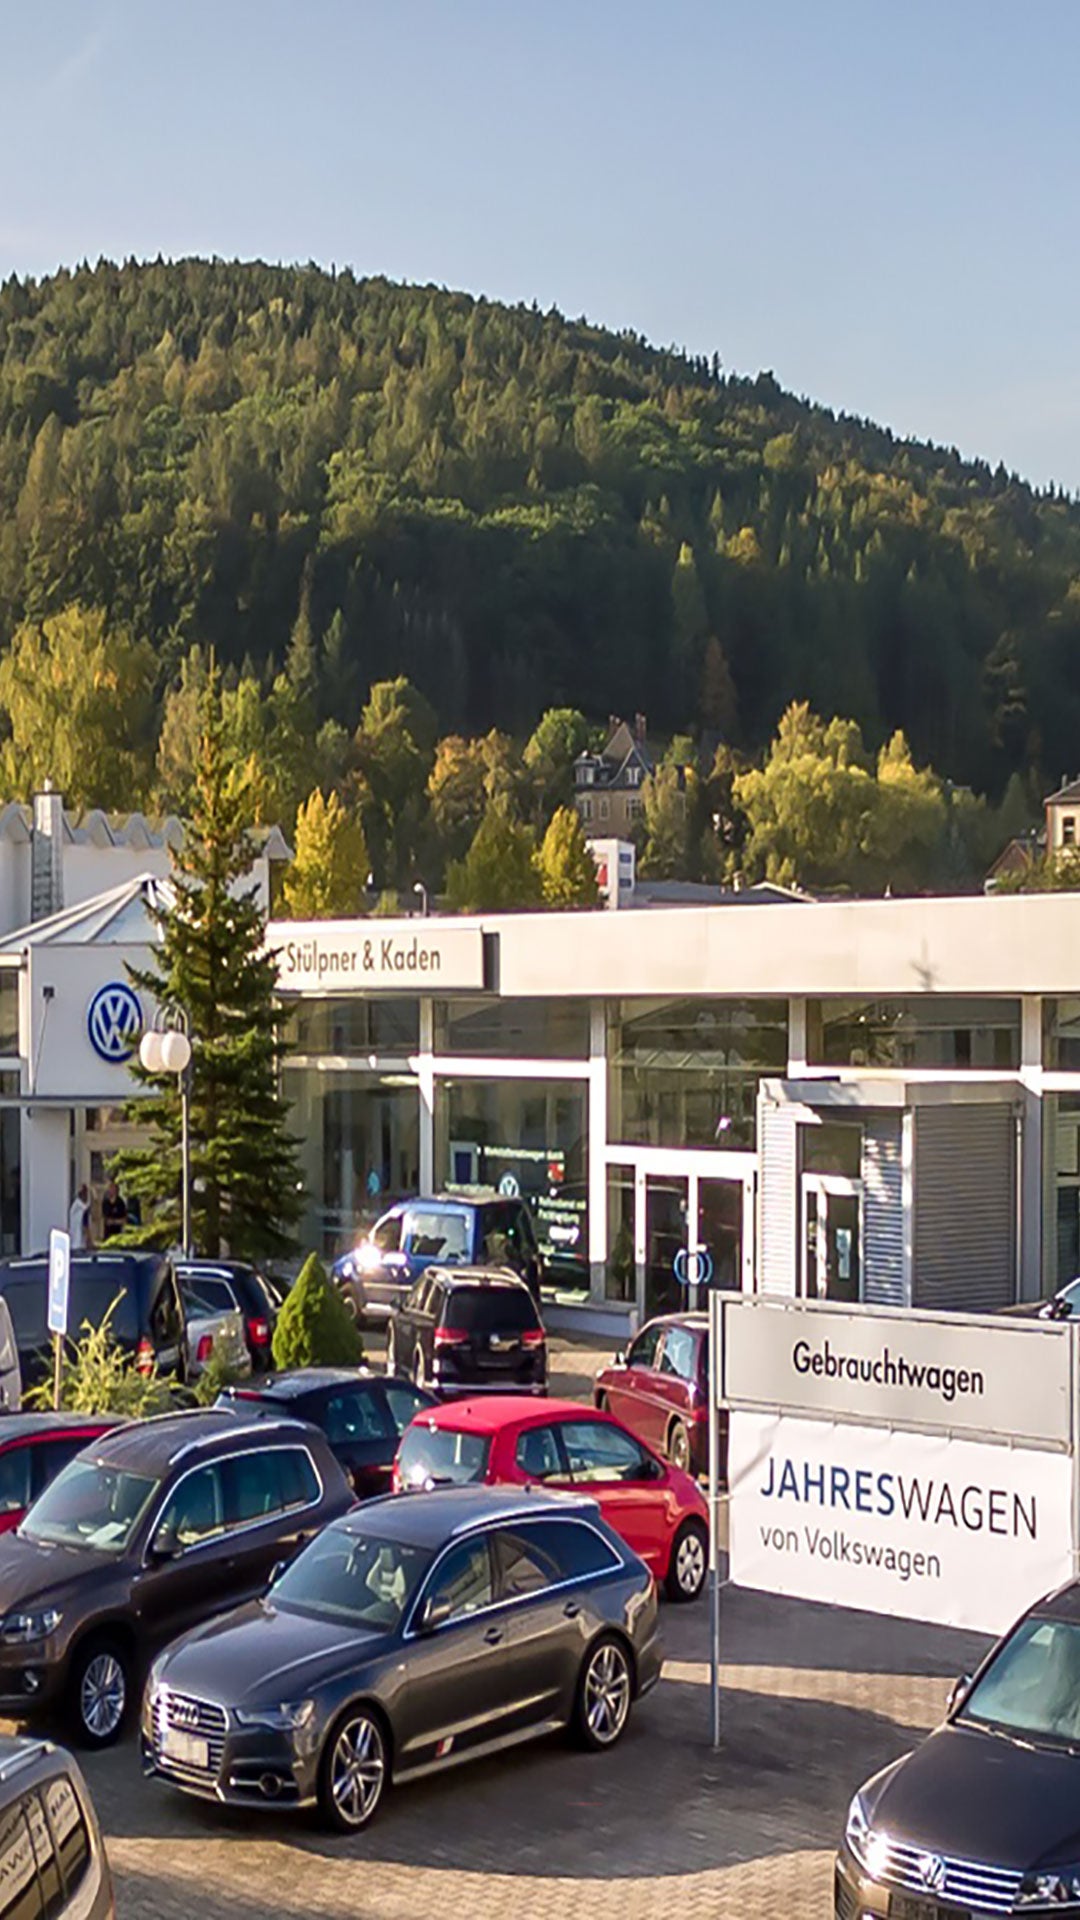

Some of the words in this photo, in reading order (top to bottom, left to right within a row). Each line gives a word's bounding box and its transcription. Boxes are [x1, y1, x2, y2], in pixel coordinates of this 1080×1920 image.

[287, 940, 357, 979] Stülpner
[362, 939, 375, 972] &
[380, 937, 441, 972] Kaden
[793, 1340, 984, 1401] Gebrauchtwagen
[760, 1456, 1037, 1540] JAHRESWAGEN
[760, 1526, 798, 1551] von
[804, 1526, 941, 1581] Volkswagen
